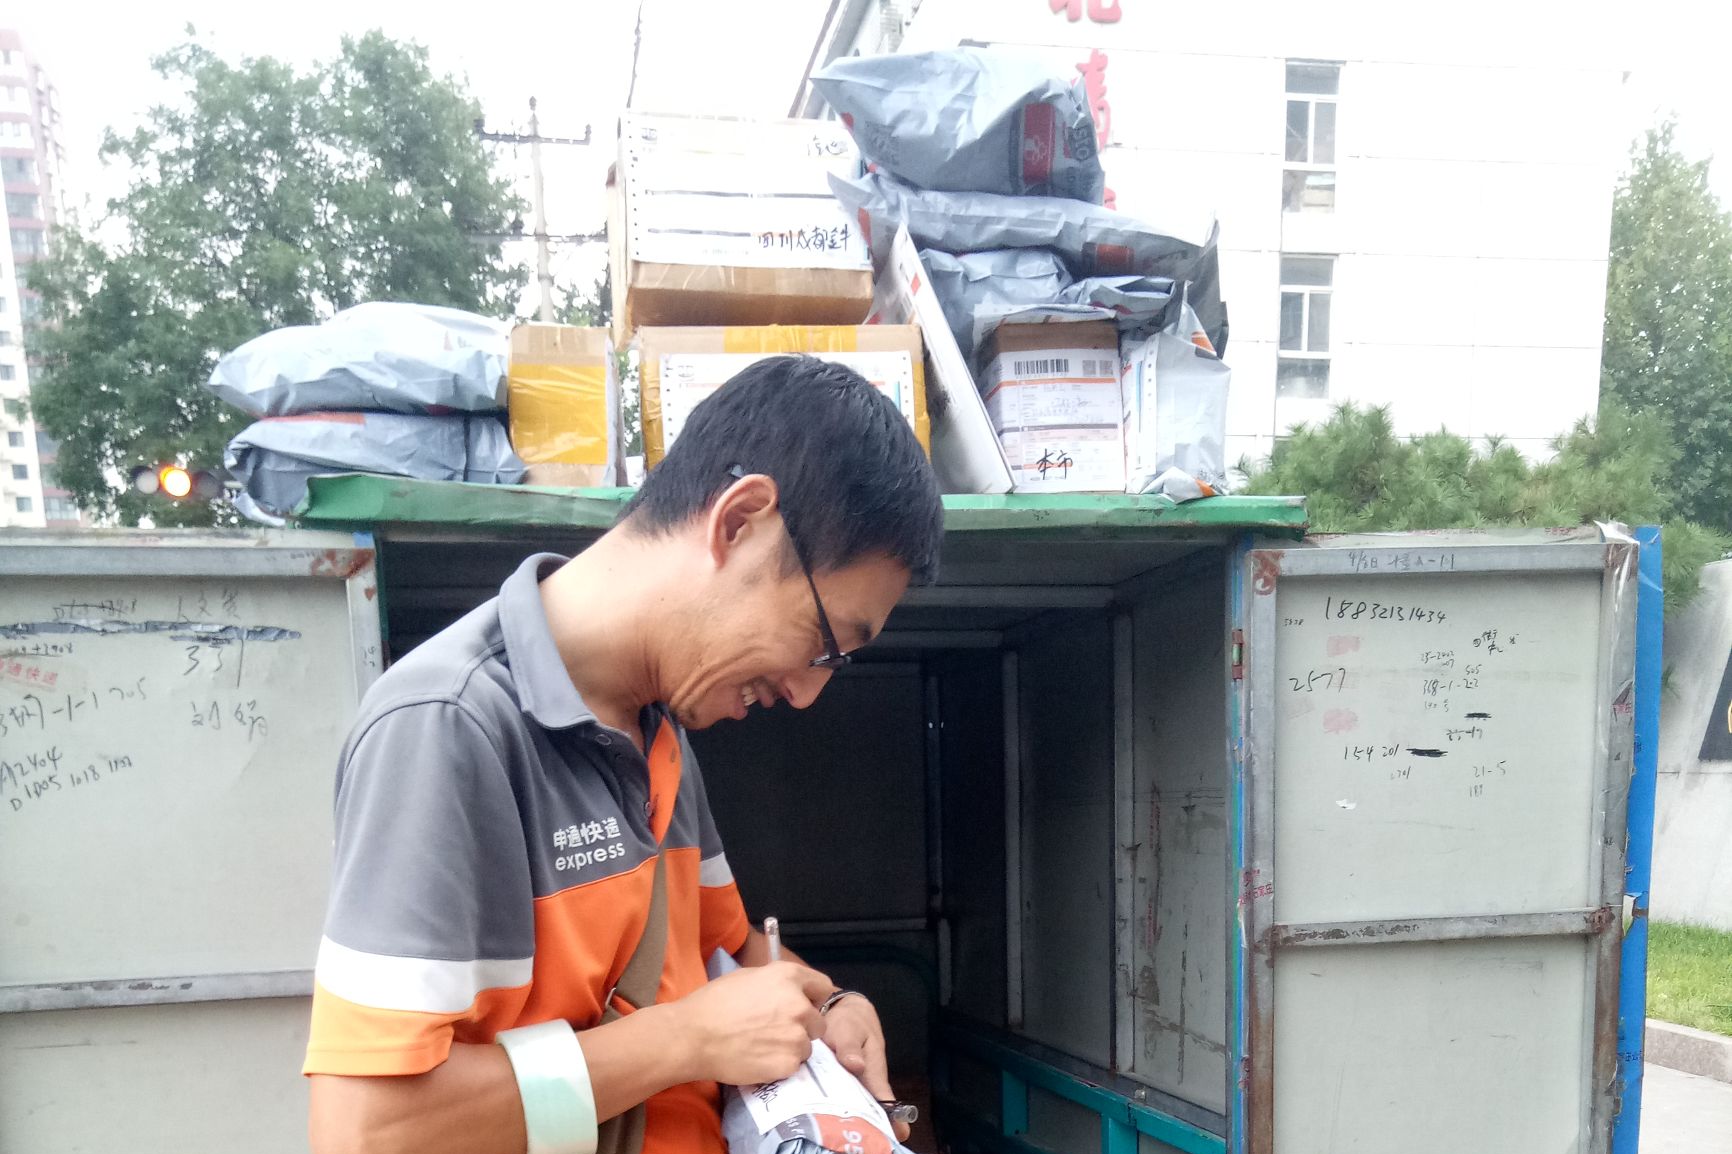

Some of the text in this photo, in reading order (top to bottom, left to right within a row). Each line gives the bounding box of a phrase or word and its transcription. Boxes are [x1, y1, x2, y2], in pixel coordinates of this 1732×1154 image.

[1036, 448, 1074, 481] 本市
[1325, 596, 1447, 624] 18832131434
[1288, 667, 1347, 693] 2577
[554, 842, 626, 872] express
